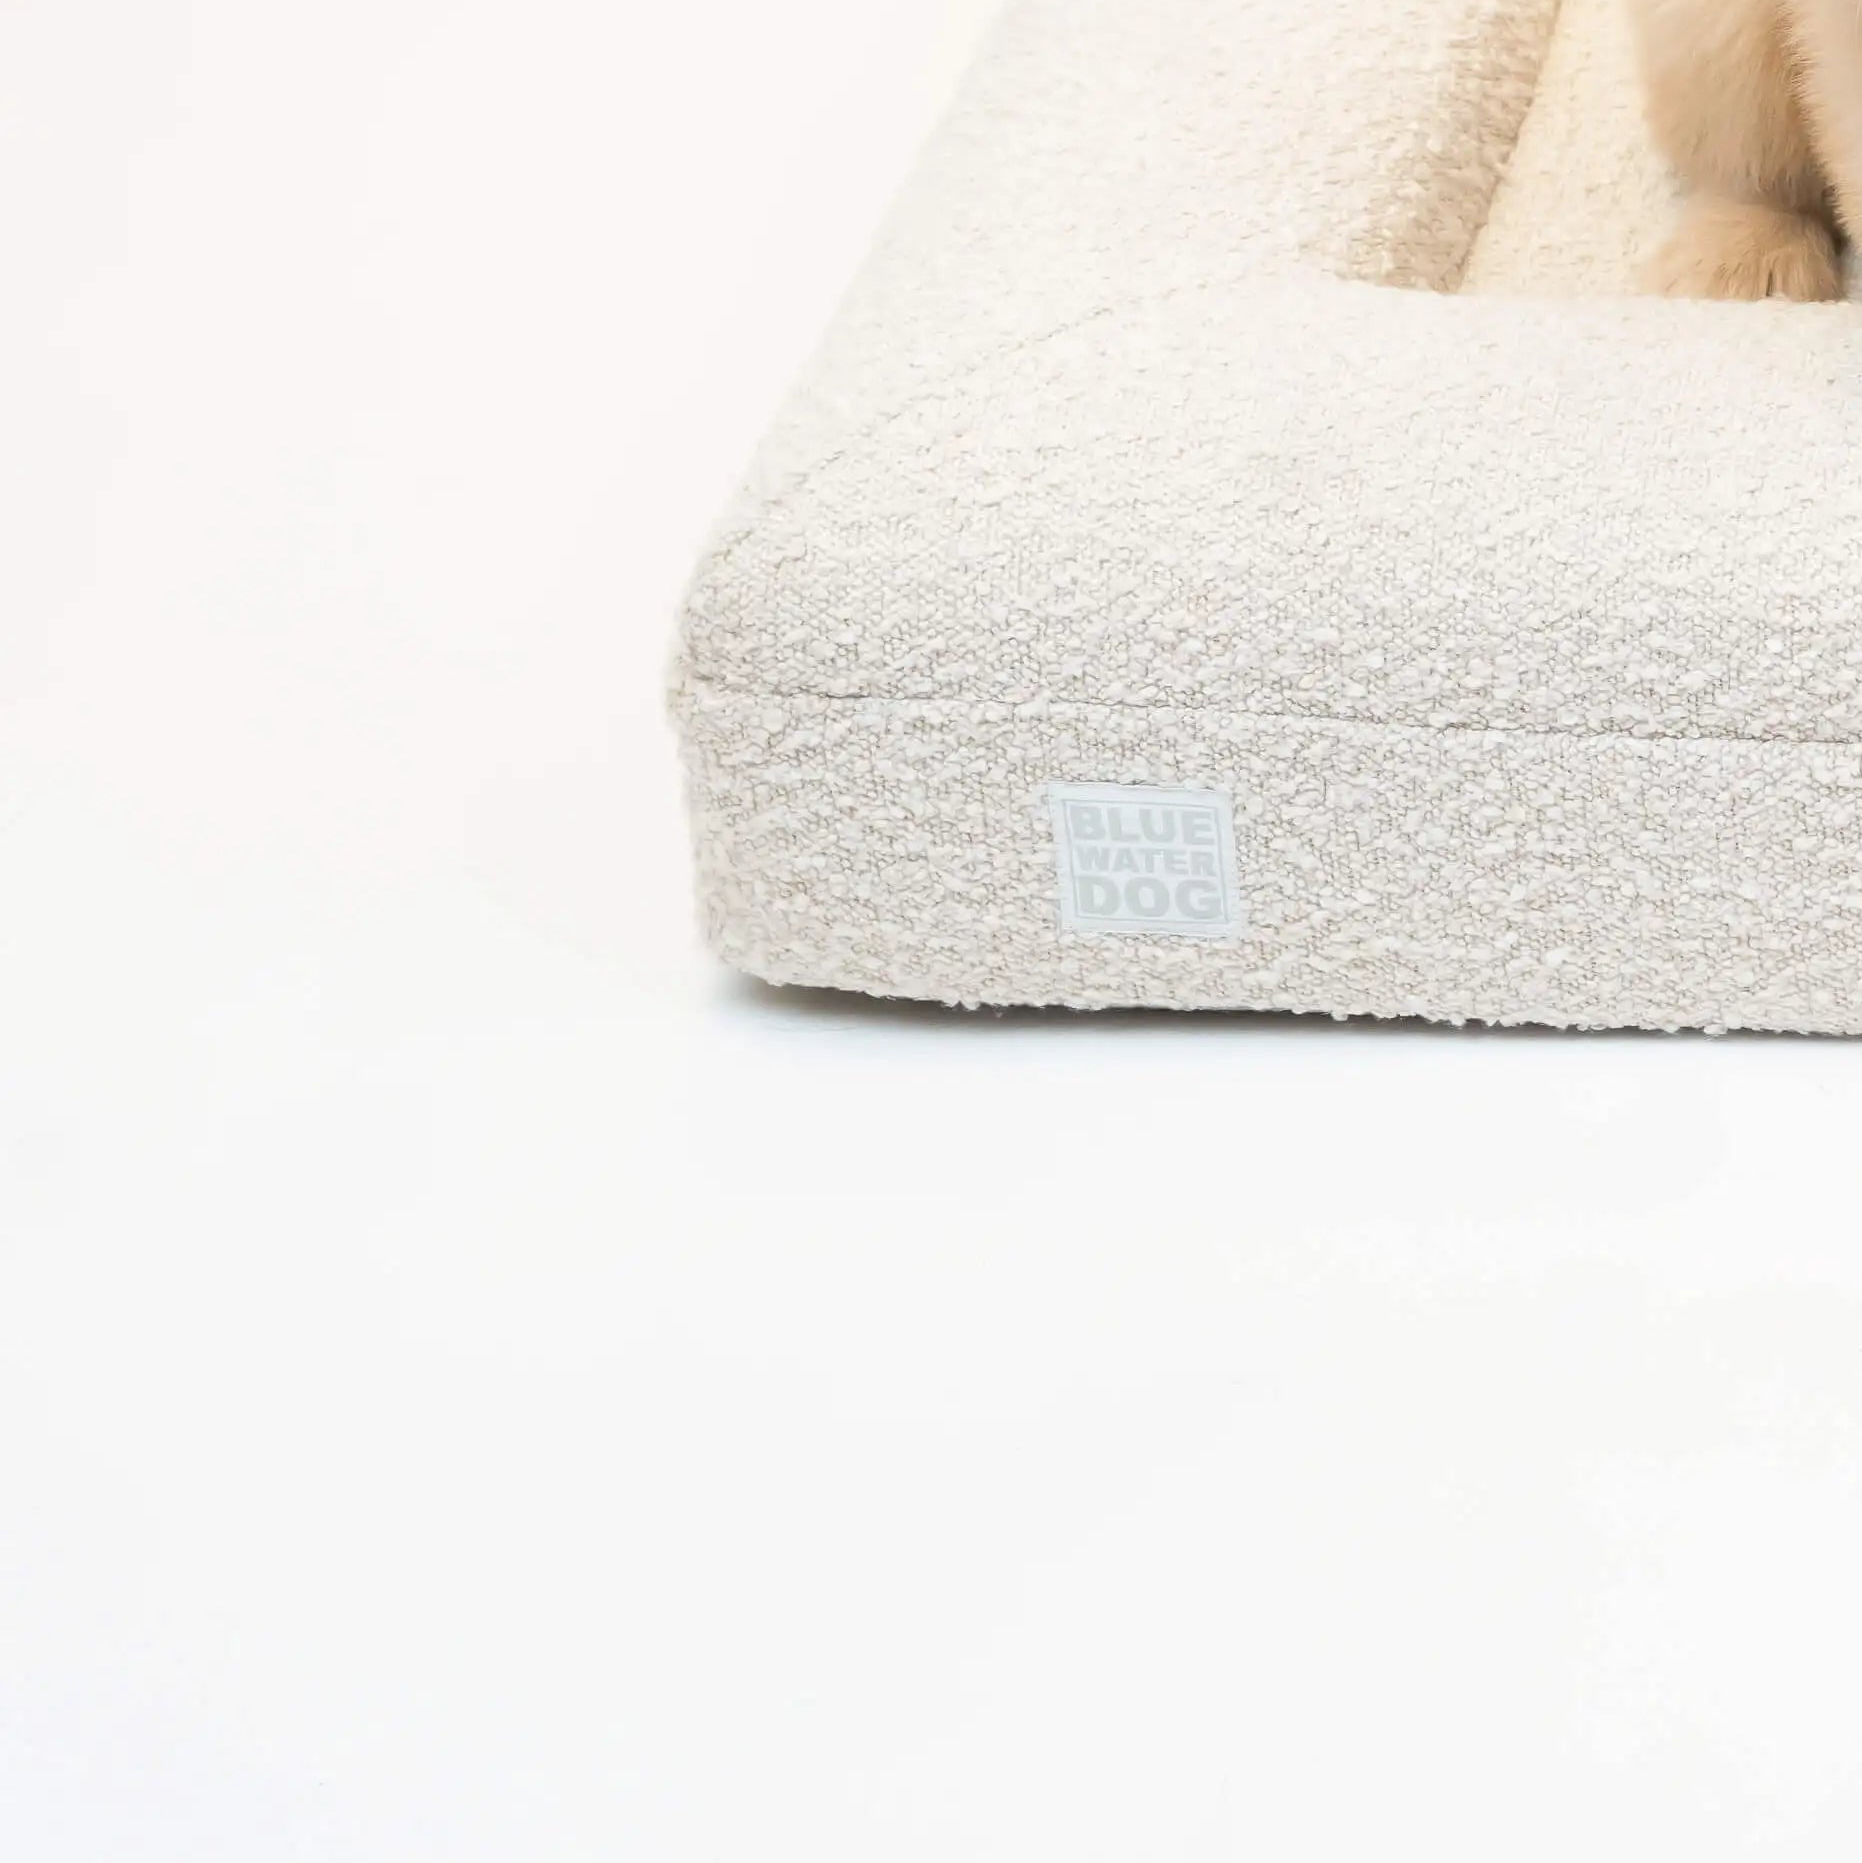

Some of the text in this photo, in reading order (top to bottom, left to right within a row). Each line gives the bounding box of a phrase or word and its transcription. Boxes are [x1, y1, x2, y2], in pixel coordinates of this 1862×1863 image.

[1069, 805, 1215, 845] BLUE
[1075, 846, 1217, 876] WATER
[1077, 876, 1223, 920] DOG
